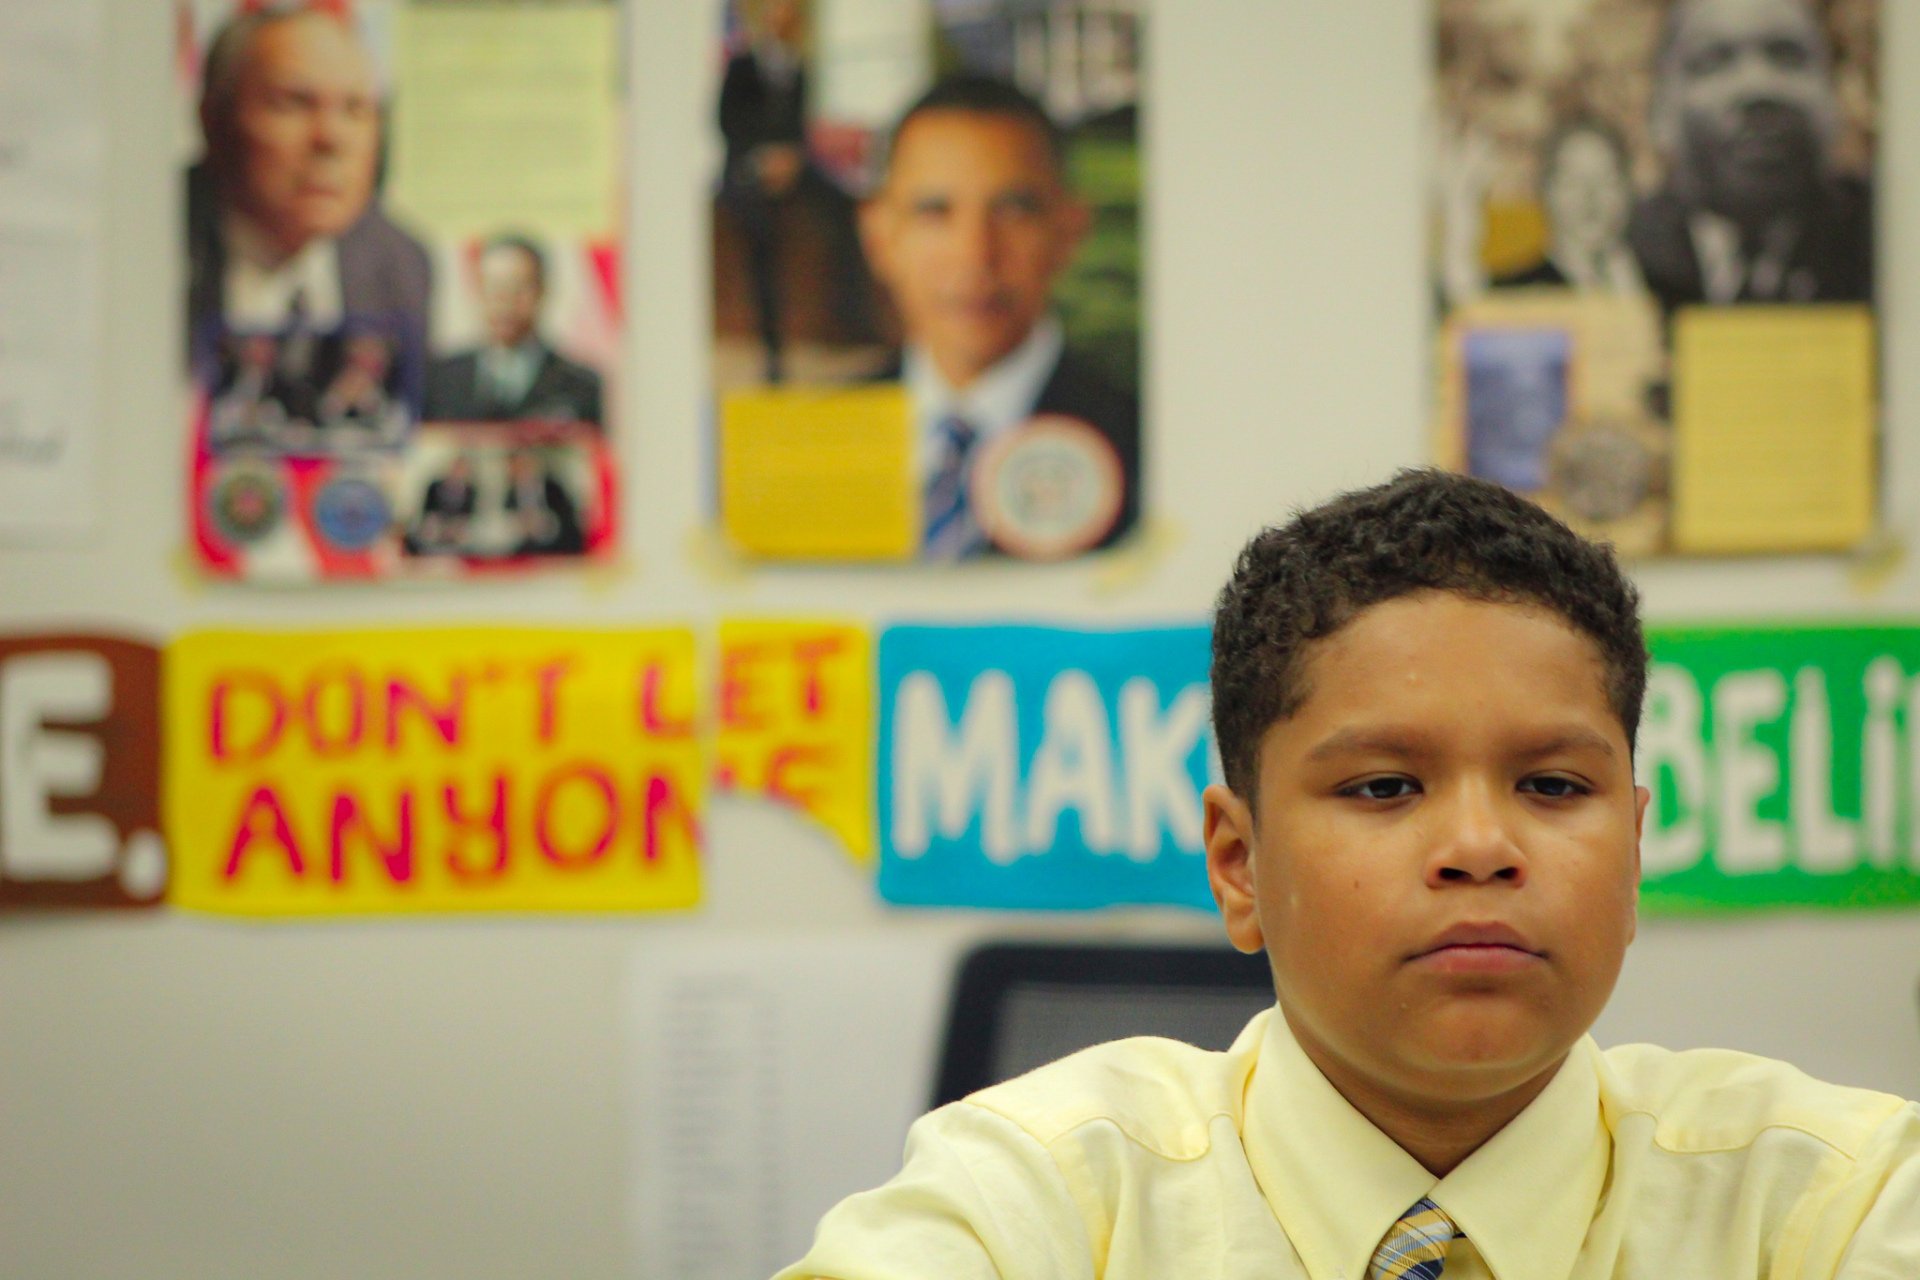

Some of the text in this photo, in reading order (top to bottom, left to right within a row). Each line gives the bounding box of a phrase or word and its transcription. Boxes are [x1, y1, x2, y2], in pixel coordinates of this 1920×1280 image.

[208, 636, 848, 768] DON'T LET
[892, 667, 1226, 866] MAK
